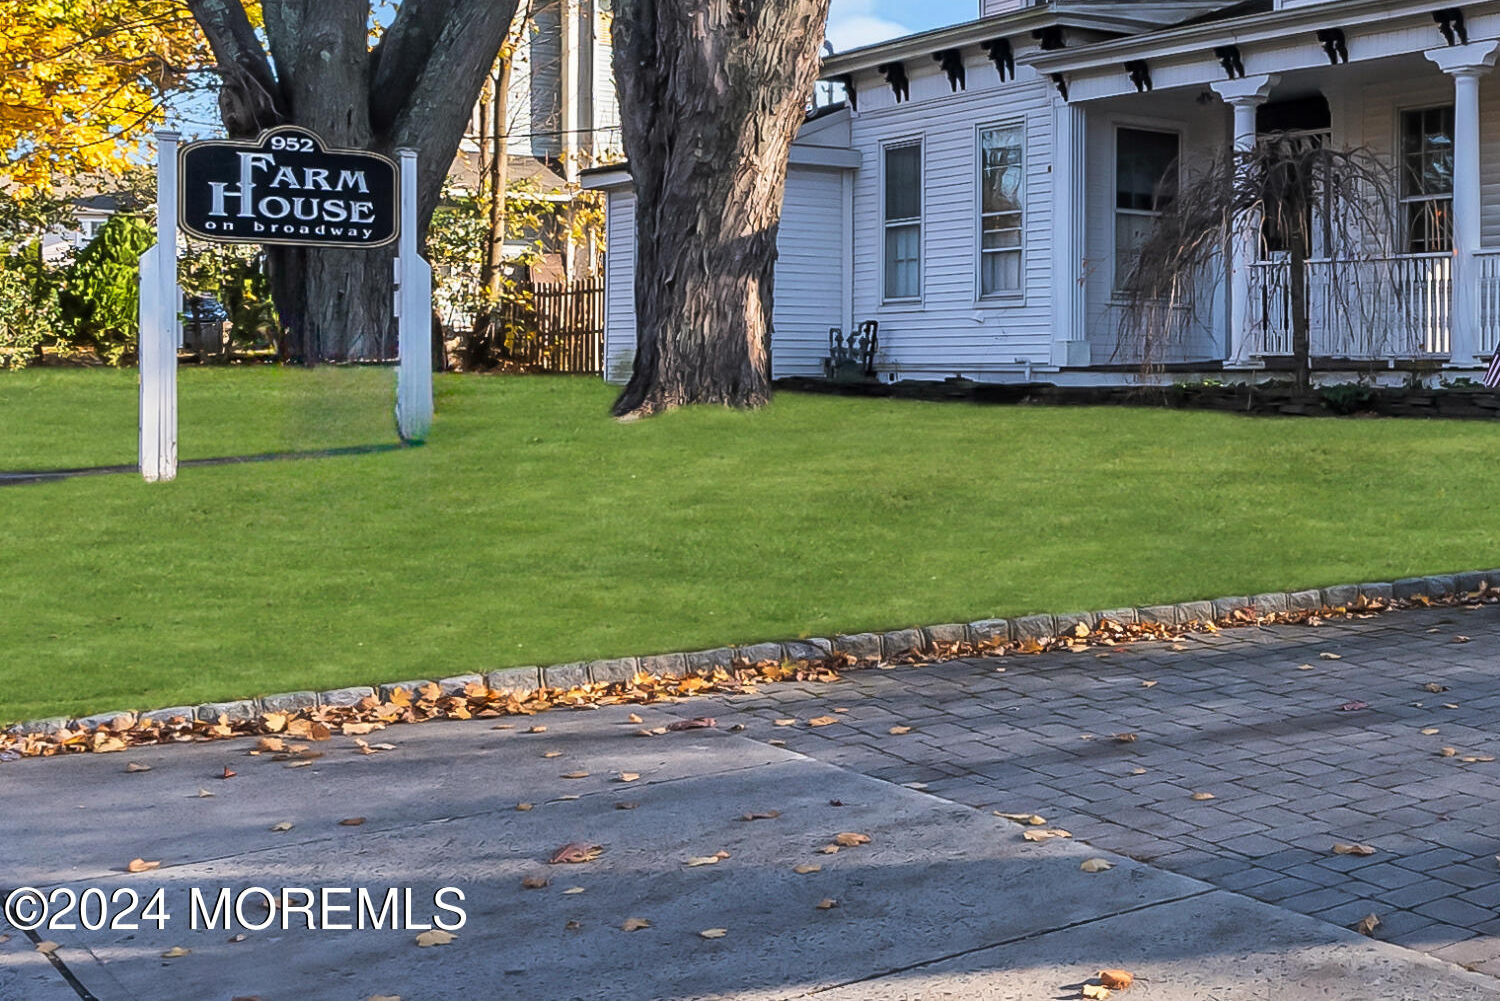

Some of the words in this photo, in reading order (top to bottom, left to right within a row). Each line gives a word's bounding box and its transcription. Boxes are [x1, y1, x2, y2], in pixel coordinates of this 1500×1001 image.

[271, 136, 314, 153] 952
[236, 151, 370, 193] FARM
[208, 181, 376, 224] HOUSE
[204, 220, 234, 231] on
[253, 221, 373, 239] broadway
